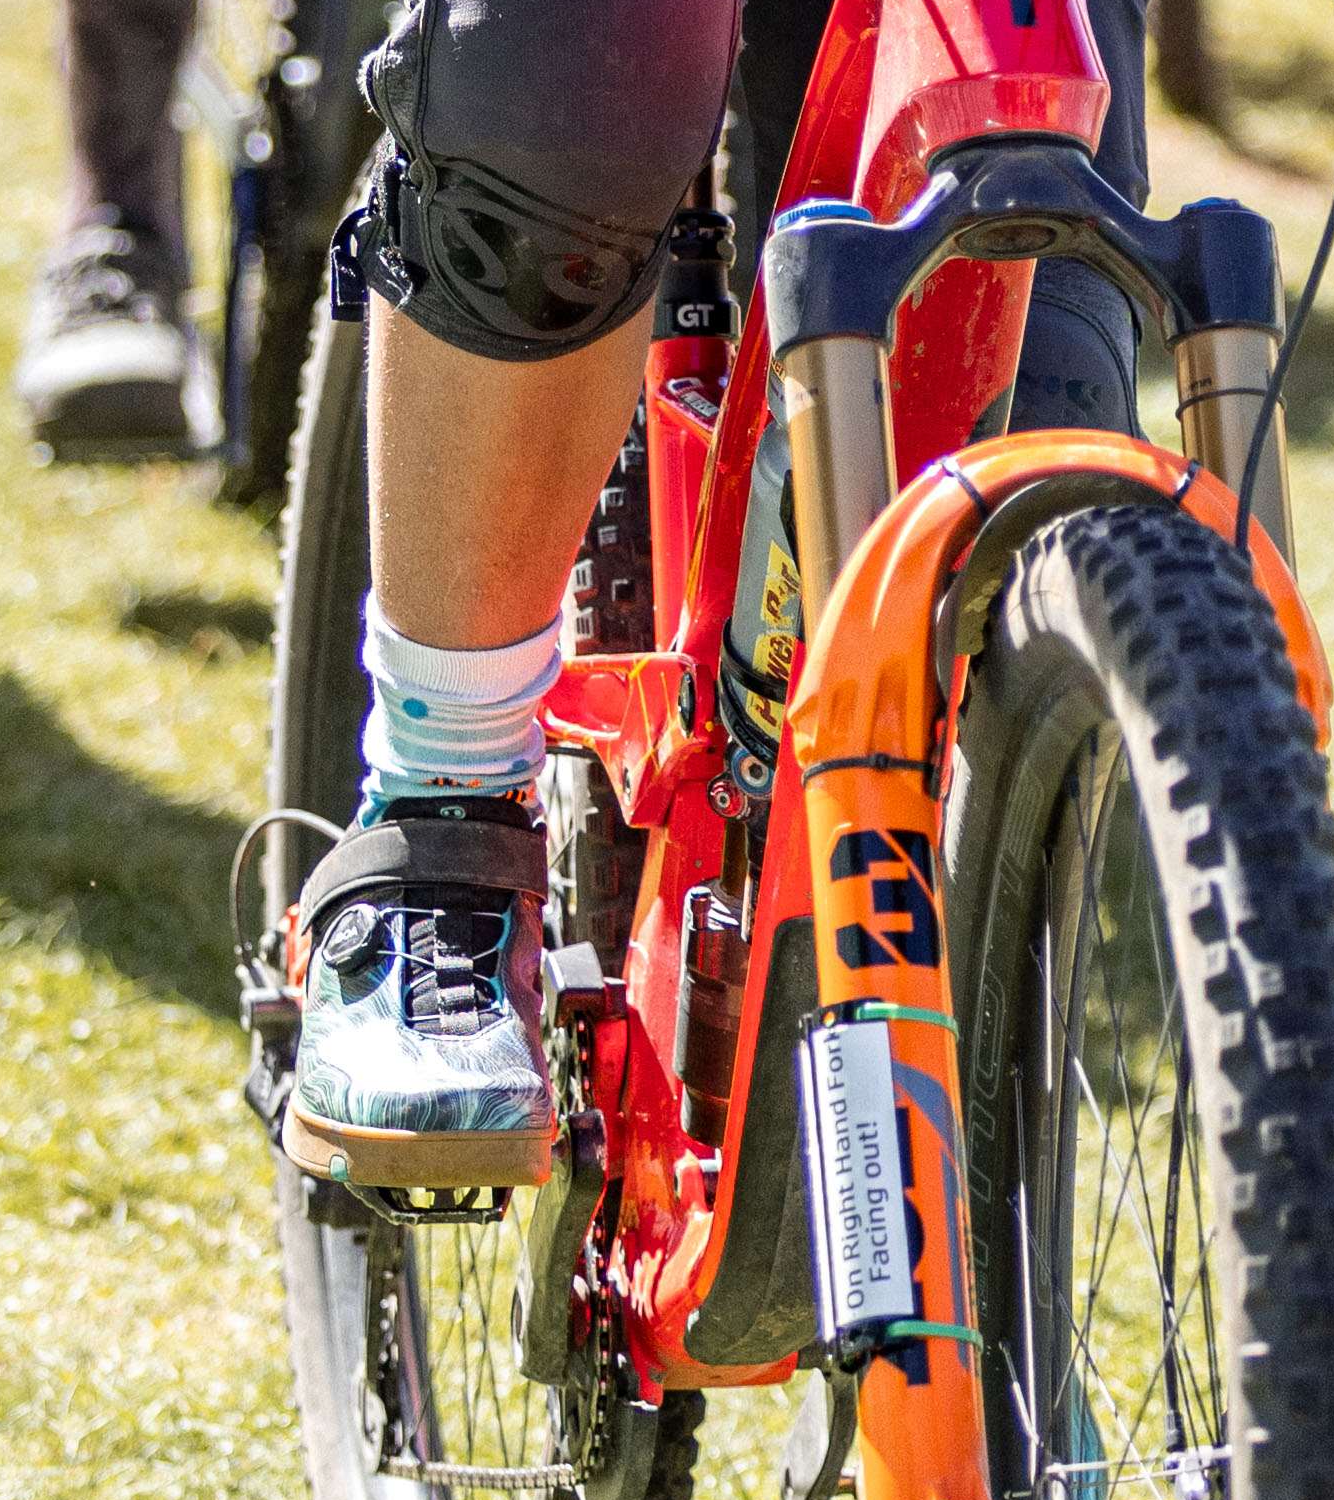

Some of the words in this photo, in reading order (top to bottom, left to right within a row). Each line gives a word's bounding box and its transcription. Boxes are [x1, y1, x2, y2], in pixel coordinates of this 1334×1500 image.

[677, 301, 716, 330] GT
[833, 1100, 853, 1176] Hand
[857, 1119, 880, 1186] out!
[838, 1181, 863, 1268] Right
[863, 1191, 890, 1282] Facing
[846, 1273, 866, 1310] On
